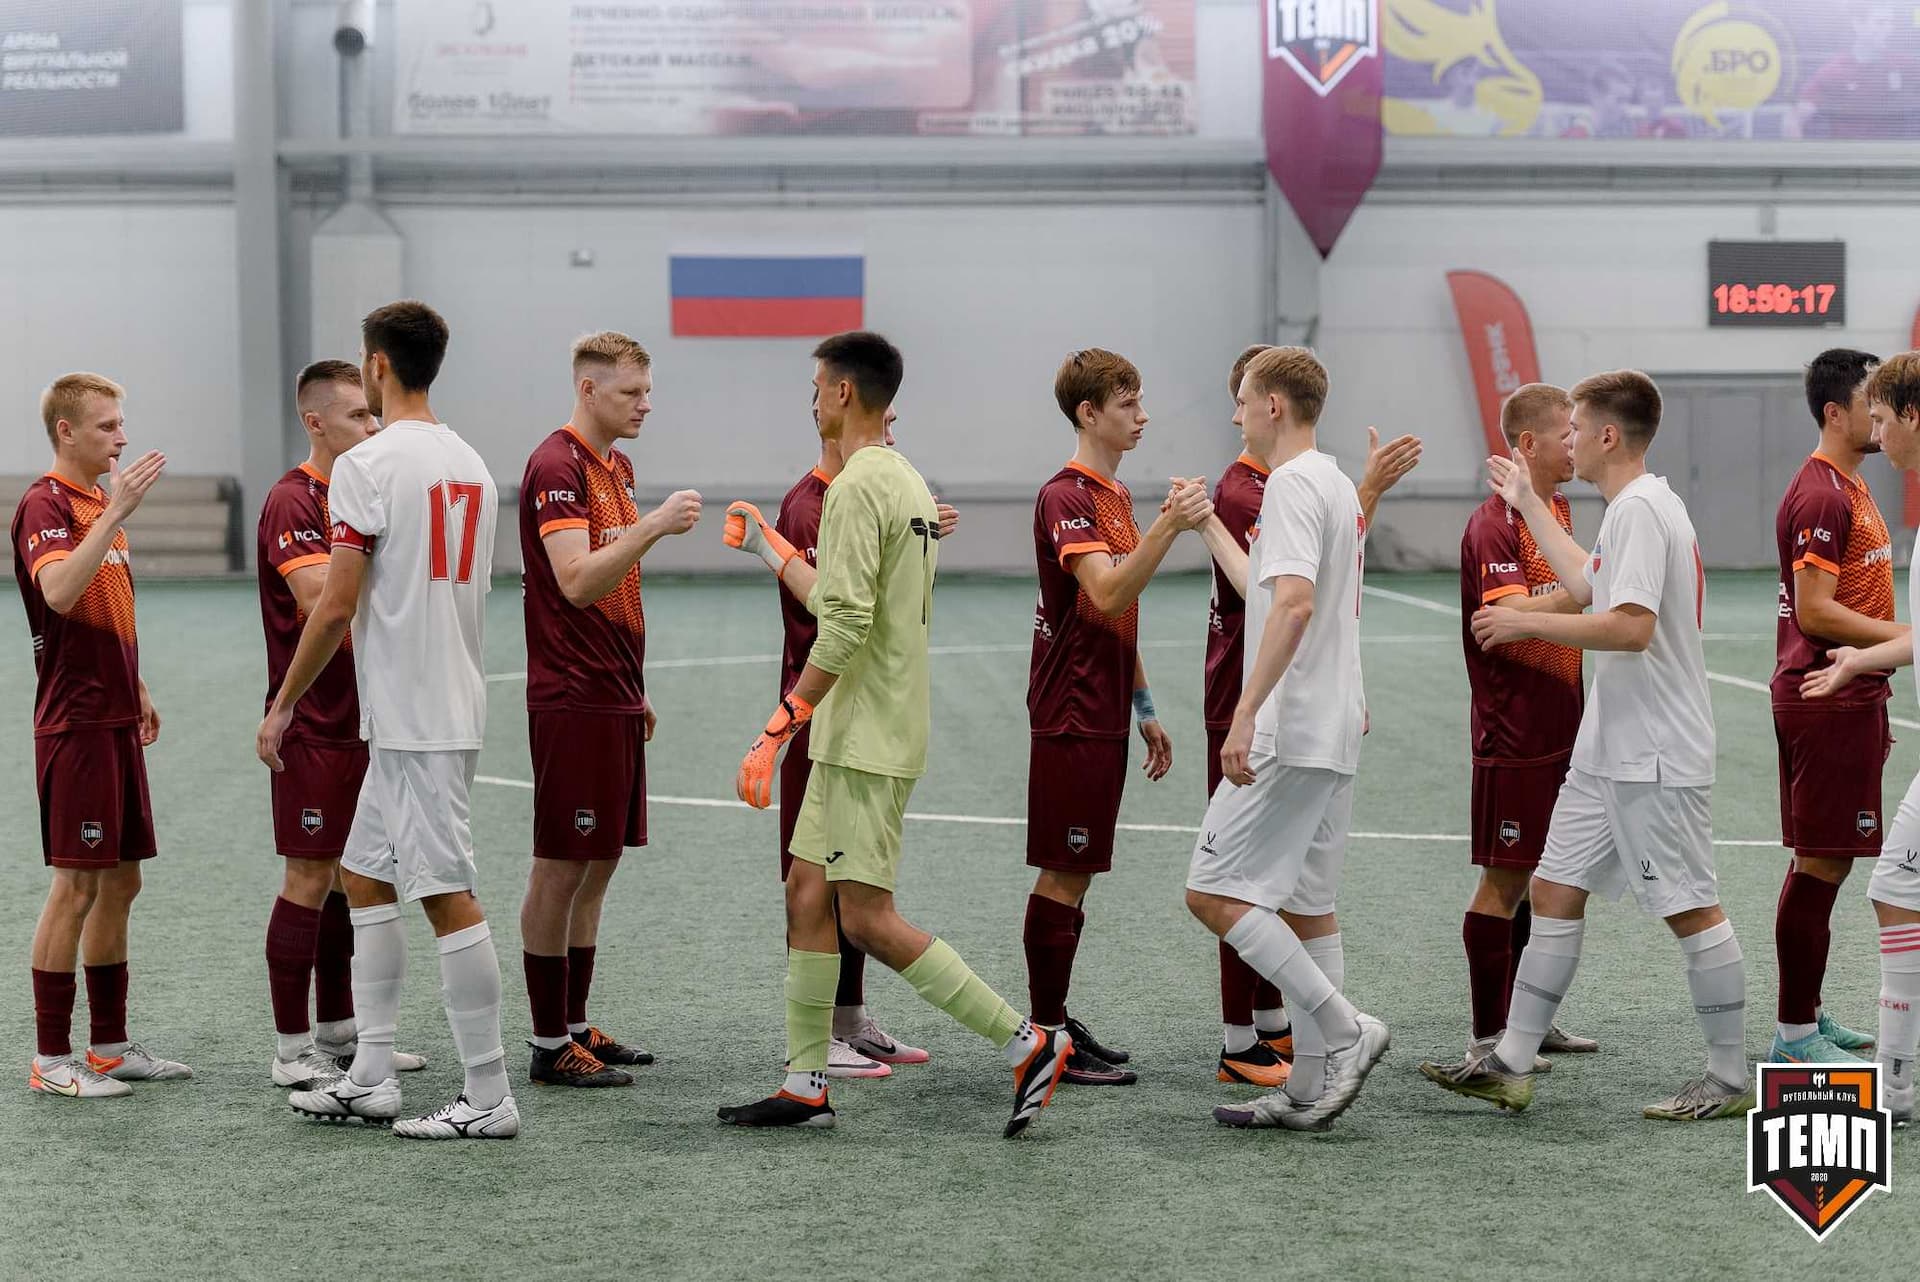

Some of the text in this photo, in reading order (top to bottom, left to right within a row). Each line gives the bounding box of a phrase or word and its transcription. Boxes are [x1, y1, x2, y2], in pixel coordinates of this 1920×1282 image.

[1278, 0, 1367, 42] ТЕМП
[548, 490, 576, 502] ПСБ
[1060, 517, 1090, 530] ПСБ
[40, 528, 68, 541] ПСБ
[427, 479, 483, 584] 17
[1489, 562, 1518, 574] ПСБ
